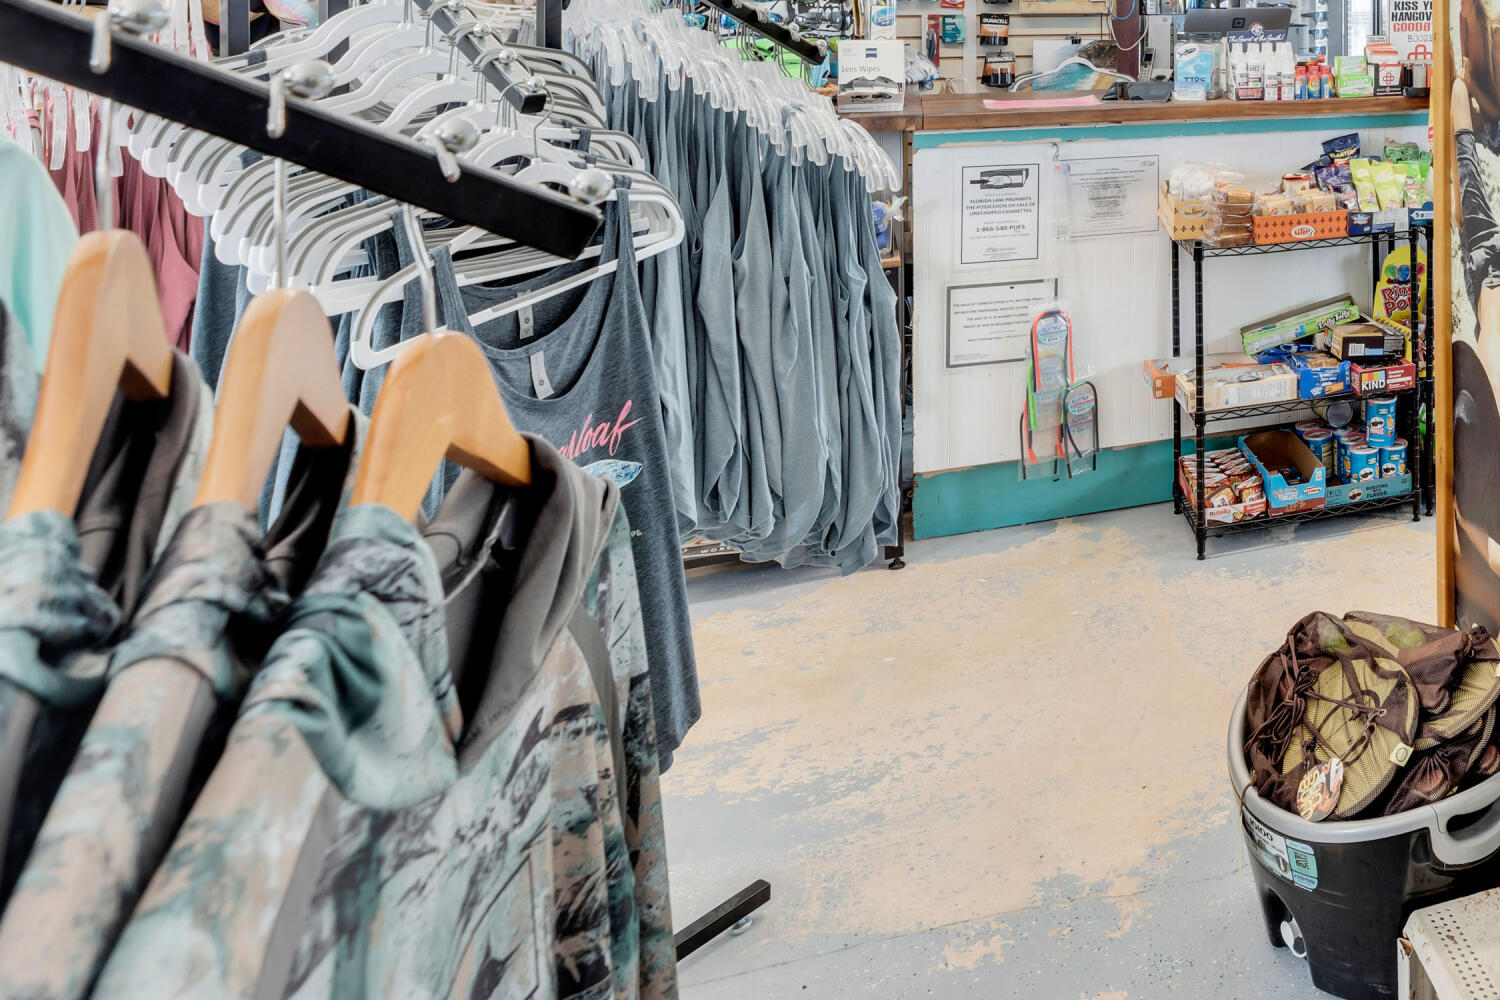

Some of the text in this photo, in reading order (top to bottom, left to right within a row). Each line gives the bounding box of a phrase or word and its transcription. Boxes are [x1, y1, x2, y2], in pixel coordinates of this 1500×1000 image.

[1394, 1, 1418, 11] KISS
[982, 17, 1009, 25] DURACELL
[1391, 11, 1432, 22] HANGOV
[1393, 22, 1431, 32] GOODB
[987, 56, 1014, 64] DURACELL
[841, 65, 881, 74] Lens Wipes
[1334, 309, 1352, 323] Taffy
[1361, 379, 1386, 392] KIND
[1366, 490, 1388, 499] FLAVOR
[1209, 508, 1231, 517] nutella
[1249, 816, 1274, 842] IGLOO
